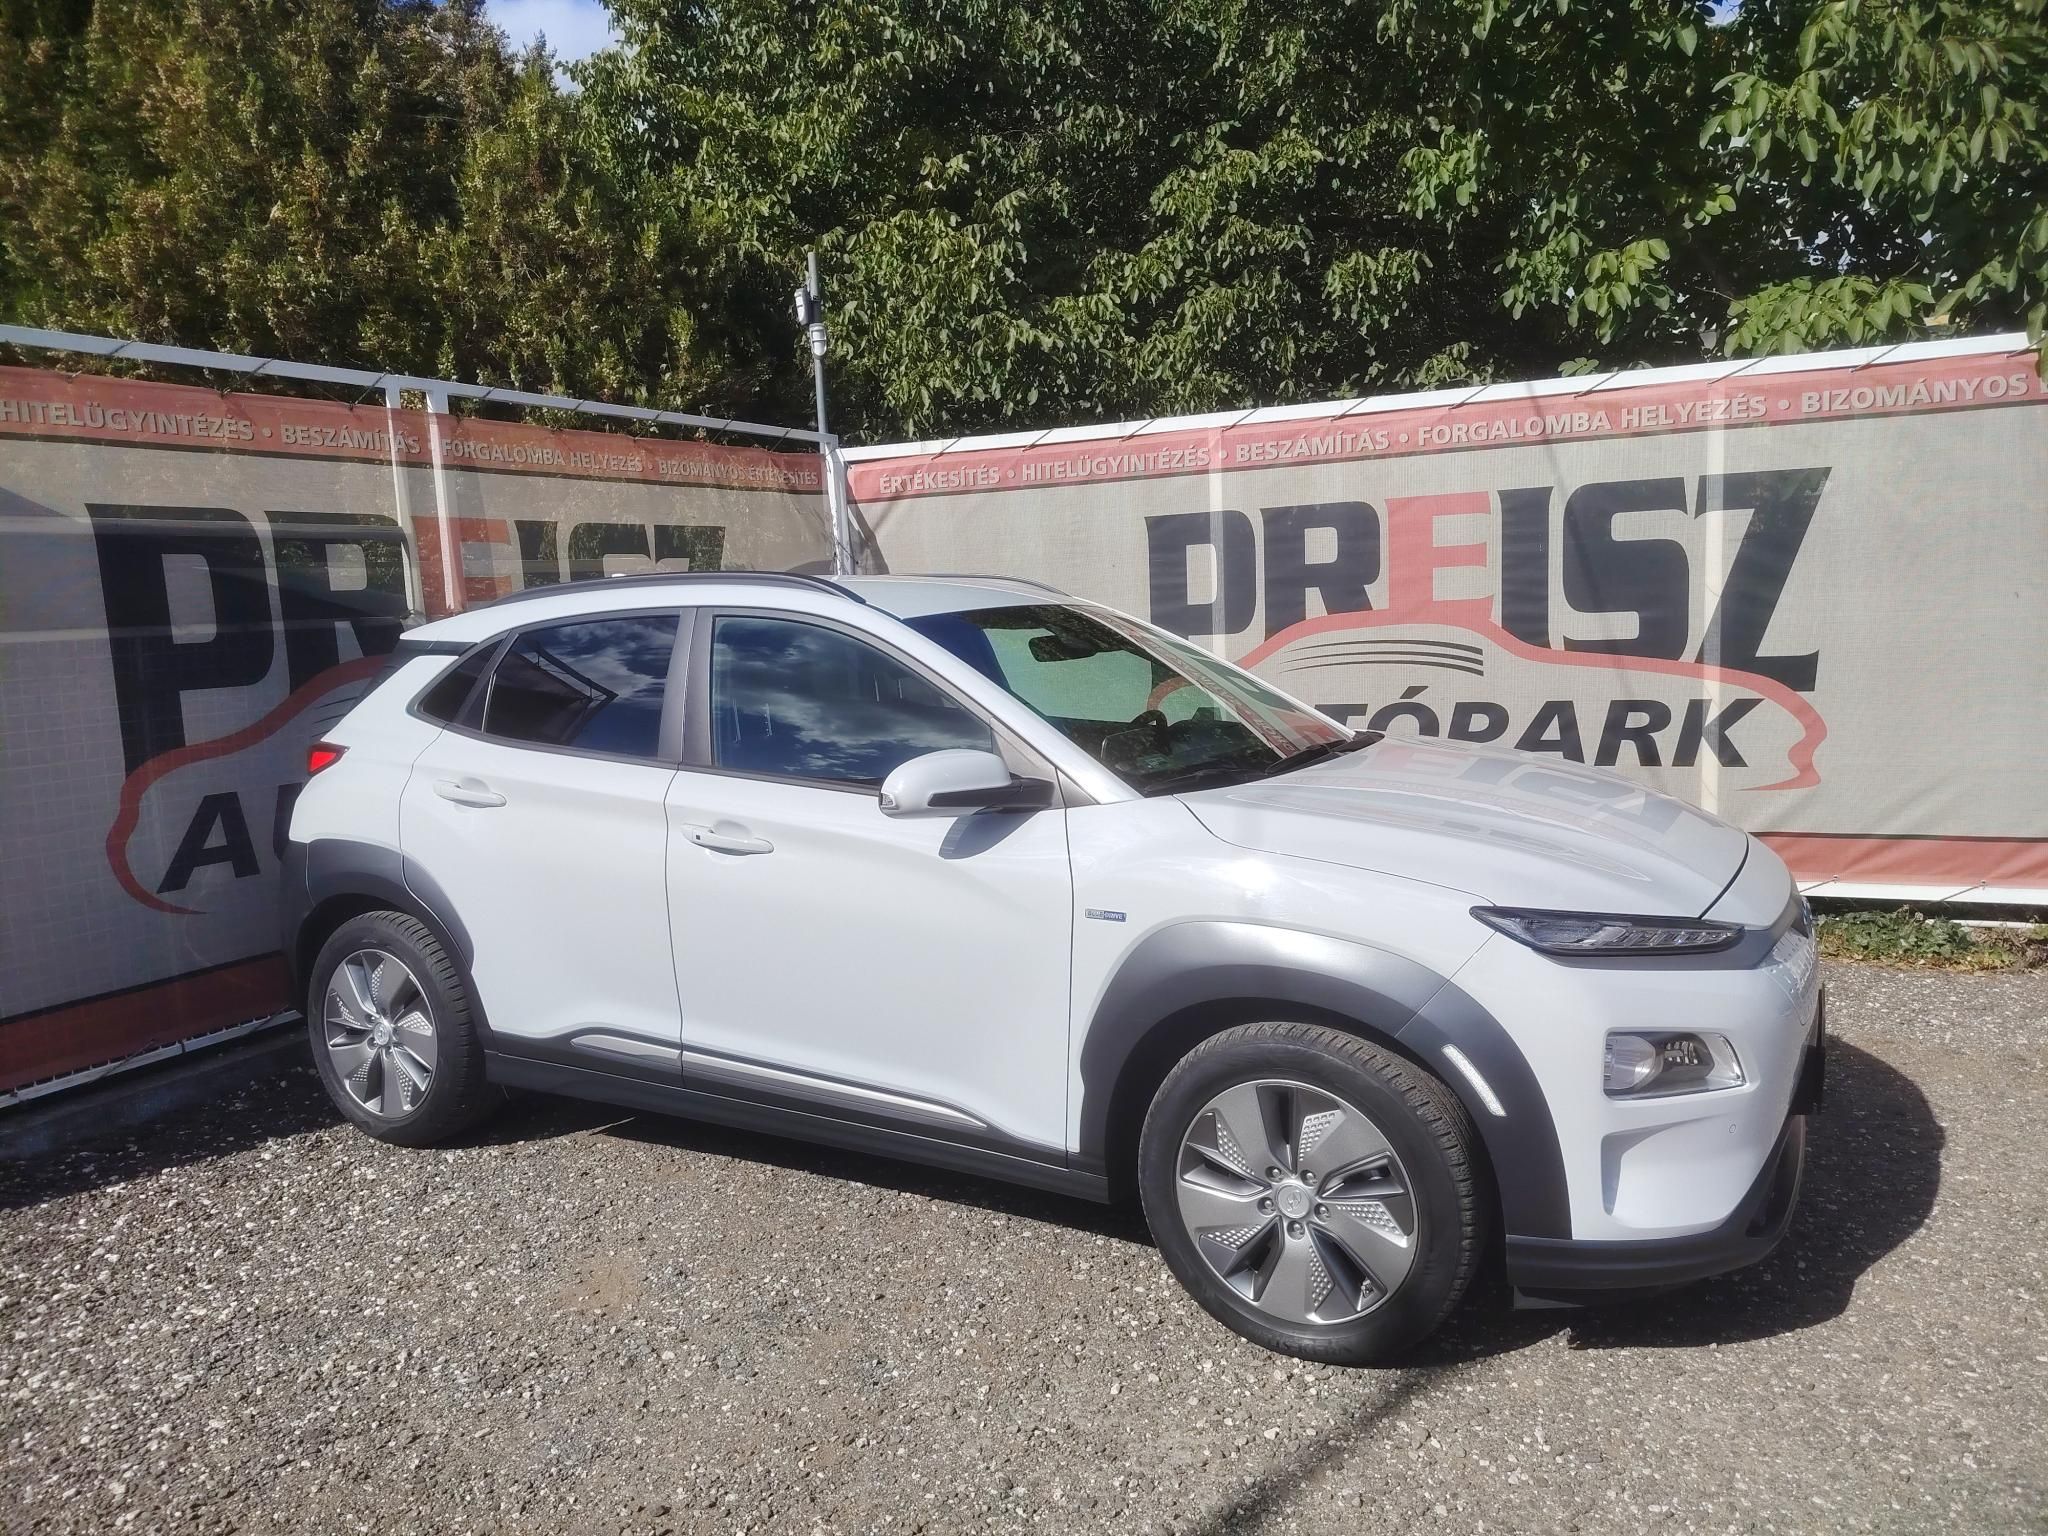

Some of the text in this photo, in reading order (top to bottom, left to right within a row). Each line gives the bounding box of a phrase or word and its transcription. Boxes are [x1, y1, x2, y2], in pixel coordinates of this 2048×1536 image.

[0, 399, 255, 442] HITELÜGYINTÉZÉS
[281, 424, 422, 455] BESZÁMÍTÁS
[442, 439, 567, 466] FORGALOMBA
[570, 452, 645, 472] HELYEZÉS
[879, 466, 1001, 494] ÉRTÉKESÍTÉS
[1022, 447, 1212, 482] HITELÜGYINTÉZÉS
[1235, 428, 1391, 463] BESZÁMÍTÁS
[1418, 410, 1613, 447] FORGALOMBA
[1621, 393, 1768, 430] HELYEZÉS
[1801, 373, 2030, 414] BIZOMÁNYOS
